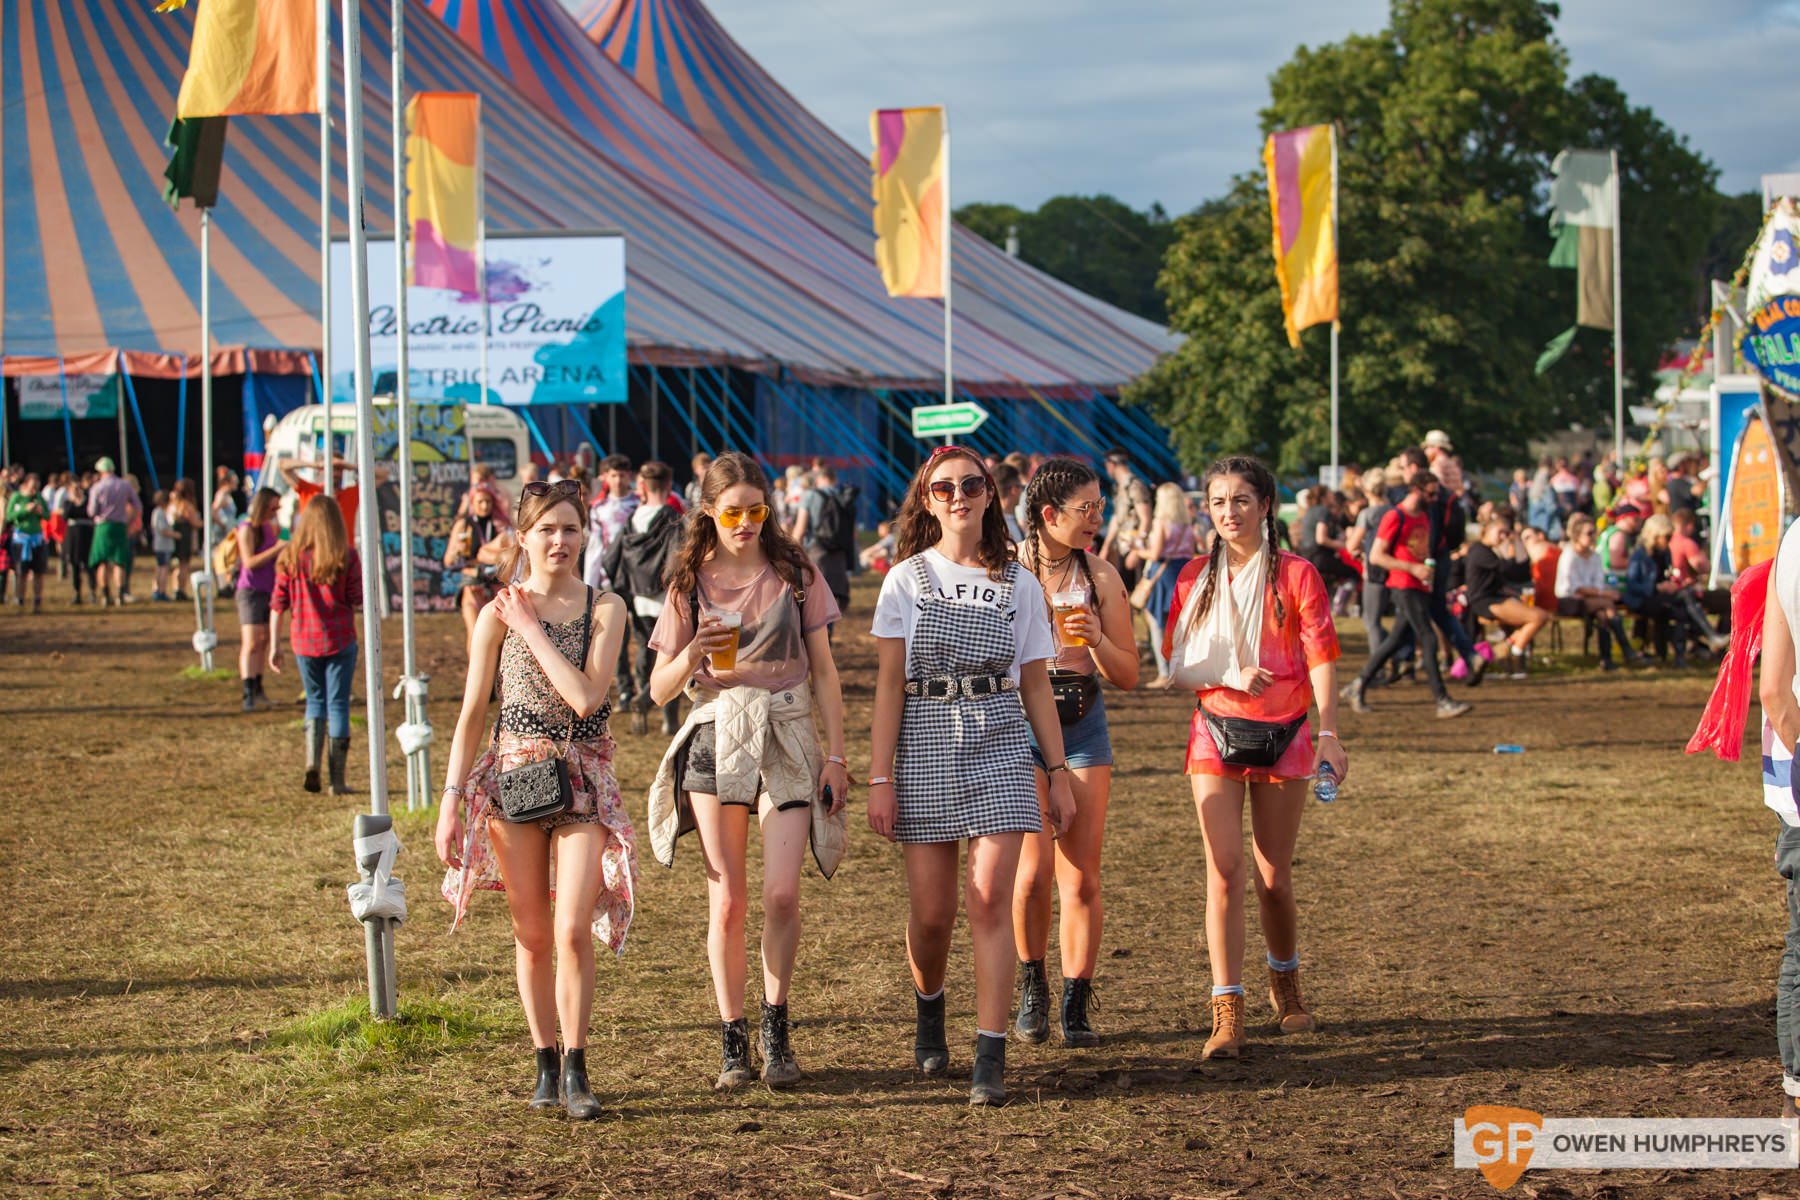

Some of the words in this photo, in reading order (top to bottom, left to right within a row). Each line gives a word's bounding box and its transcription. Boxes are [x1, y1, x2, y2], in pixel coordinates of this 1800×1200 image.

[368, 304, 482, 336] Elctric
[498, 303, 604, 333] Picnic
[500, 365, 606, 384] ARENA
